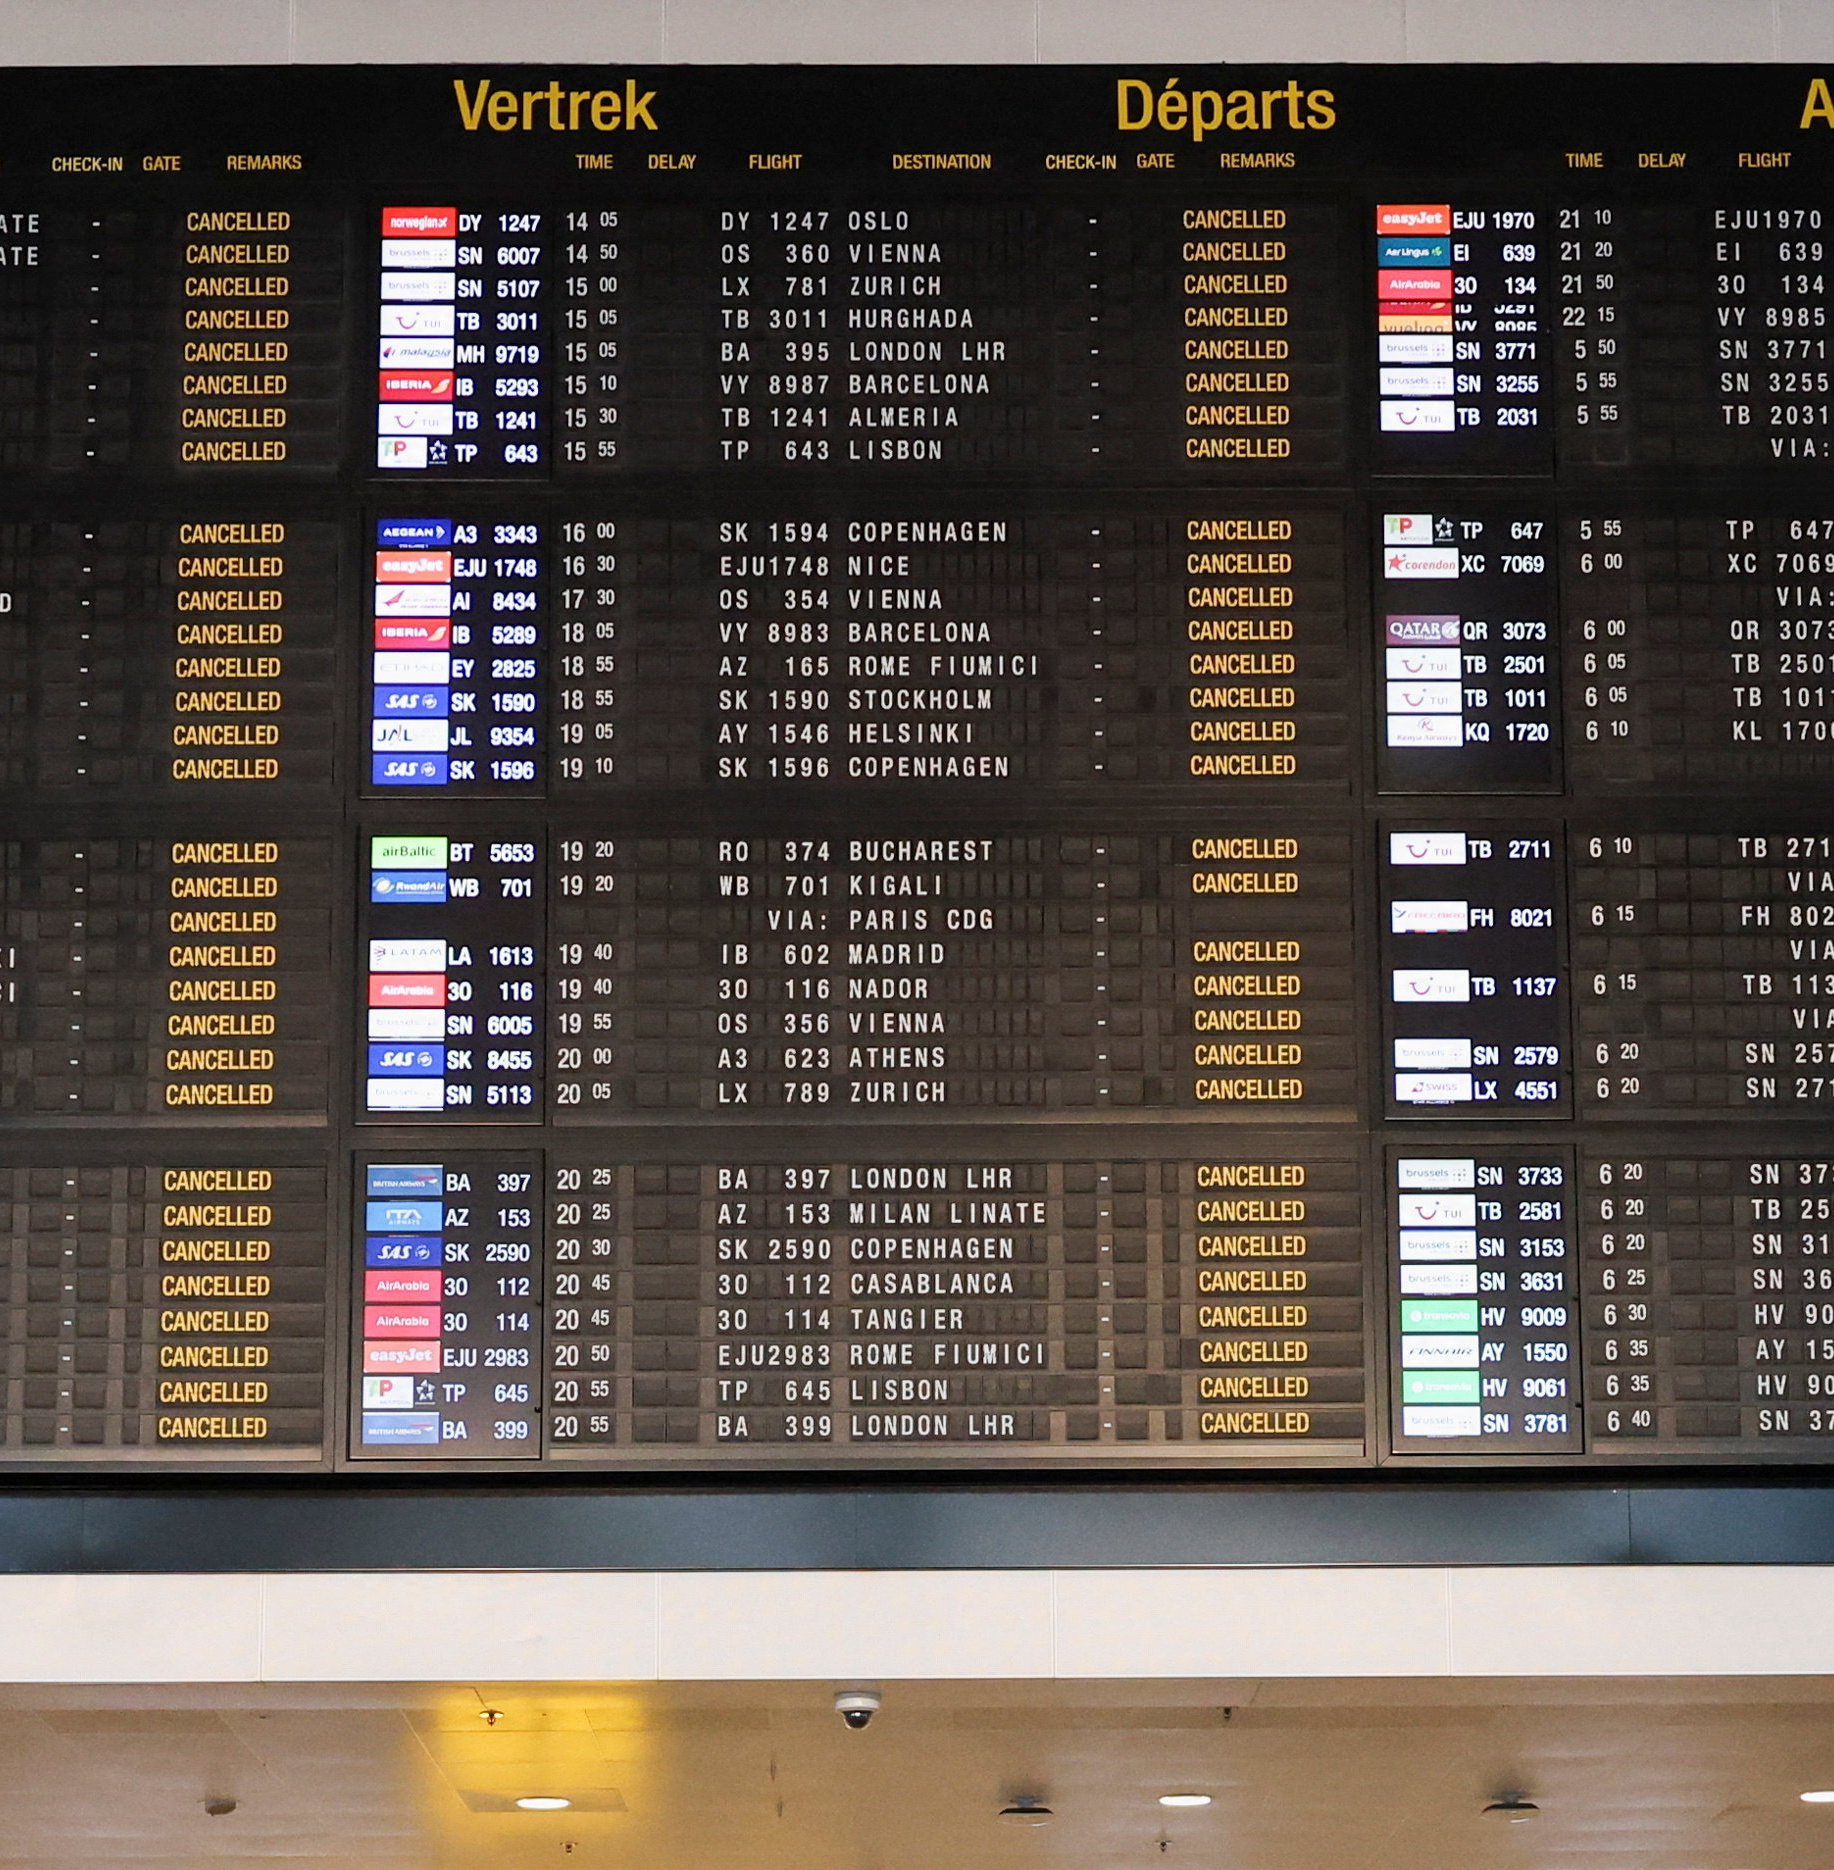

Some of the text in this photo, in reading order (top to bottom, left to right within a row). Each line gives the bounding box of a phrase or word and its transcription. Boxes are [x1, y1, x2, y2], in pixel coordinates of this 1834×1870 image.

[453, 79, 659, 131] Vertrek
[1117, 77, 1336, 142] Départs
[52, 156, 123, 172] CHECK-IN
[142, 155, 181, 171] GATE
[227, 154, 302, 170] REMARKS
[576, 152, 1295, 170] TIME DELAY FLIGHT DESTINATION CHECK-IN GATE REMARKS
[1565, 152, 1604, 168] TIME
[1638, 154, 1686, 168] DELAY
[1738, 152, 1792, 168] FLIGHT
[187, 211, 290, 232] CANCELLED
[721, 209, 1286, 231] DY 1247 OSLO CANCELLED
[1716, 242, 1740, 261] EI
[1779, 242, 1823, 262] 639
[185, 276, 289, 297] CANCELLED
[721, 341, 1005, 362] BA 395 LONDON LHR
[385, 377, 539, 397] IBERIA IB 5293
[182, 408, 287, 428] CANCELLED
[1405, 559, 1456, 571] corendon
[1727, 553, 1757, 574] XC
[1389, 621, 1441, 635] QATAR
[719, 687, 1295, 711] SK 1590 STOCKHOLM CANCELLED
[173, 724, 279, 746] CANCELLED
[382, 842, 535, 863] airBaltic BT 5653
[1741, 905, 1770, 926] FH
[717, 1044, 1302, 1069] A3 623 ATHENS CANCELLED
[164, 1169, 272, 1192] CANCELLED
[1406, 1166, 1563, 1186] brussels SN 3733
[1752, 1233, 1782, 1255] SN
[159, 1381, 268, 1403] CANCELLED
[718, 1376, 1309, 1401] TP 645 LISBON CANCELLED
